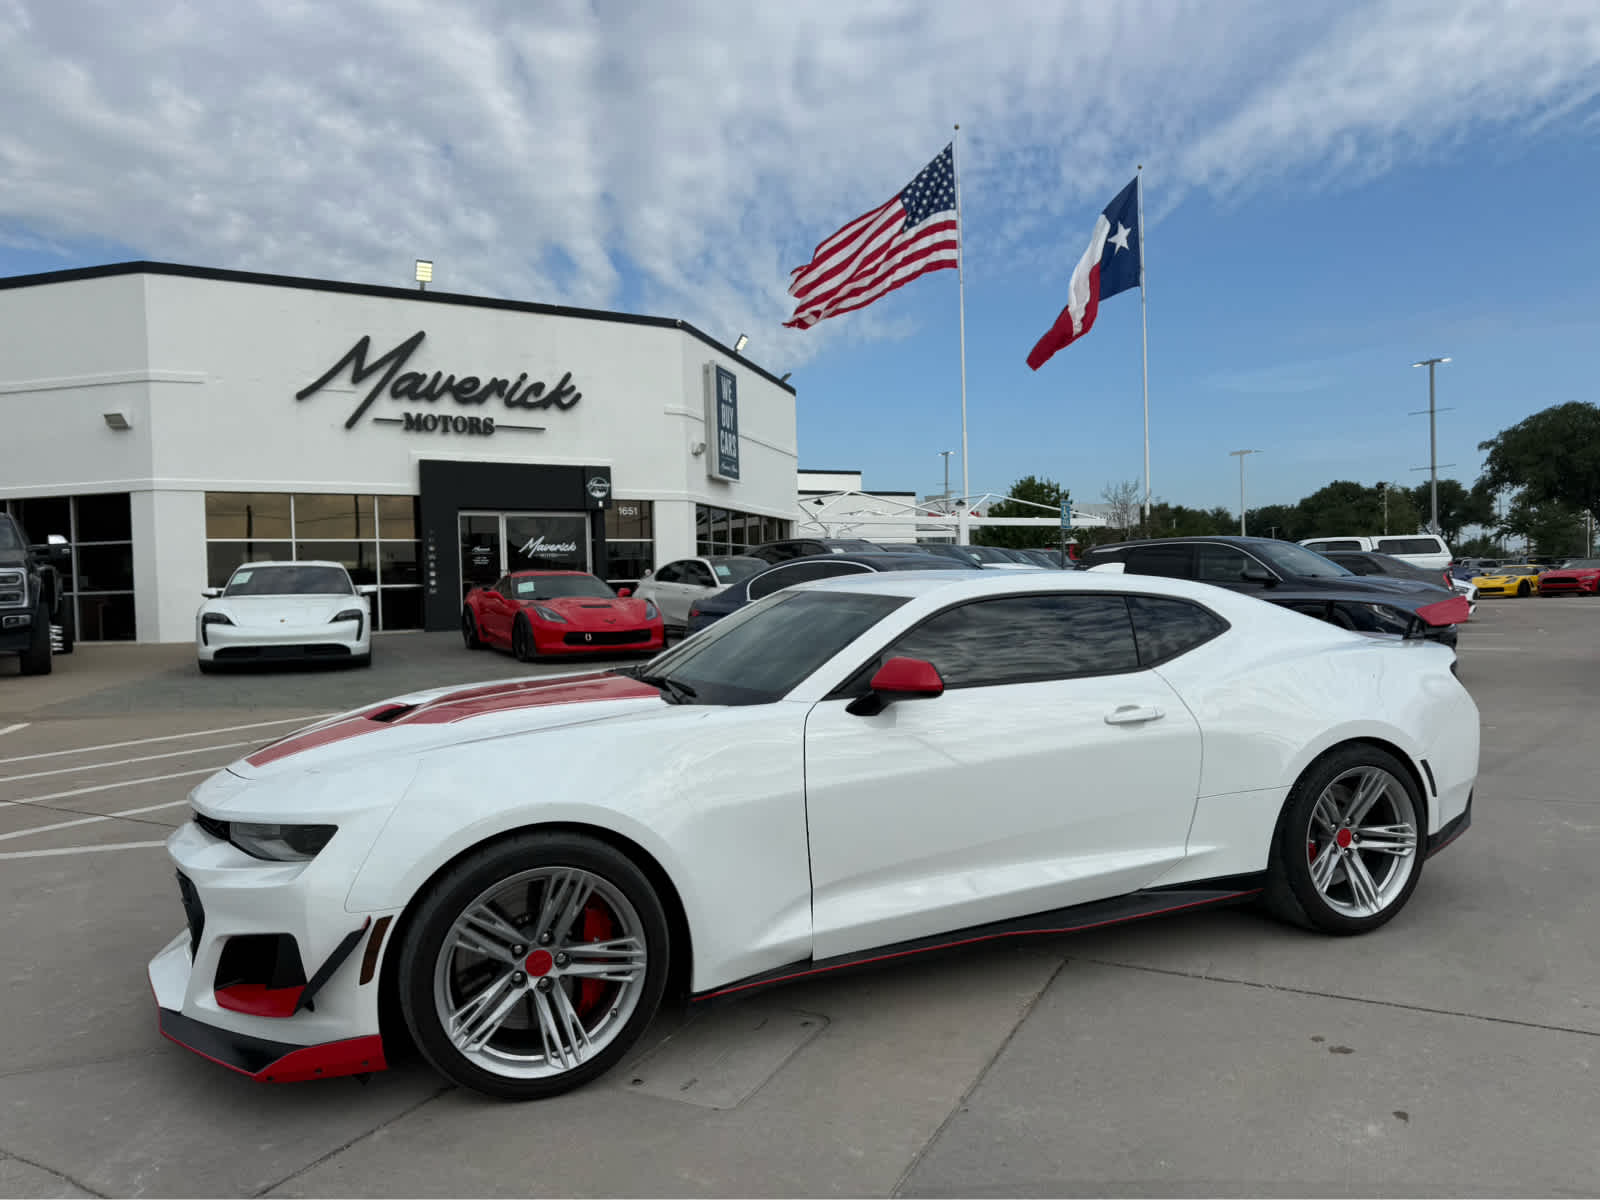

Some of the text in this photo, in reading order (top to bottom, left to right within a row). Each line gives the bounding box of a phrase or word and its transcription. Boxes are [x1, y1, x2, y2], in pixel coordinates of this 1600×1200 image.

[296, 330, 582, 429] Maverick
[720, 376, 732, 402] WE
[403, 412, 495, 435] MOTORS
[721, 403, 733, 430] BUY
[720, 429, 737, 457] CARS
[618, 506, 638, 516] 1651
[518, 535, 577, 558] Maverick
